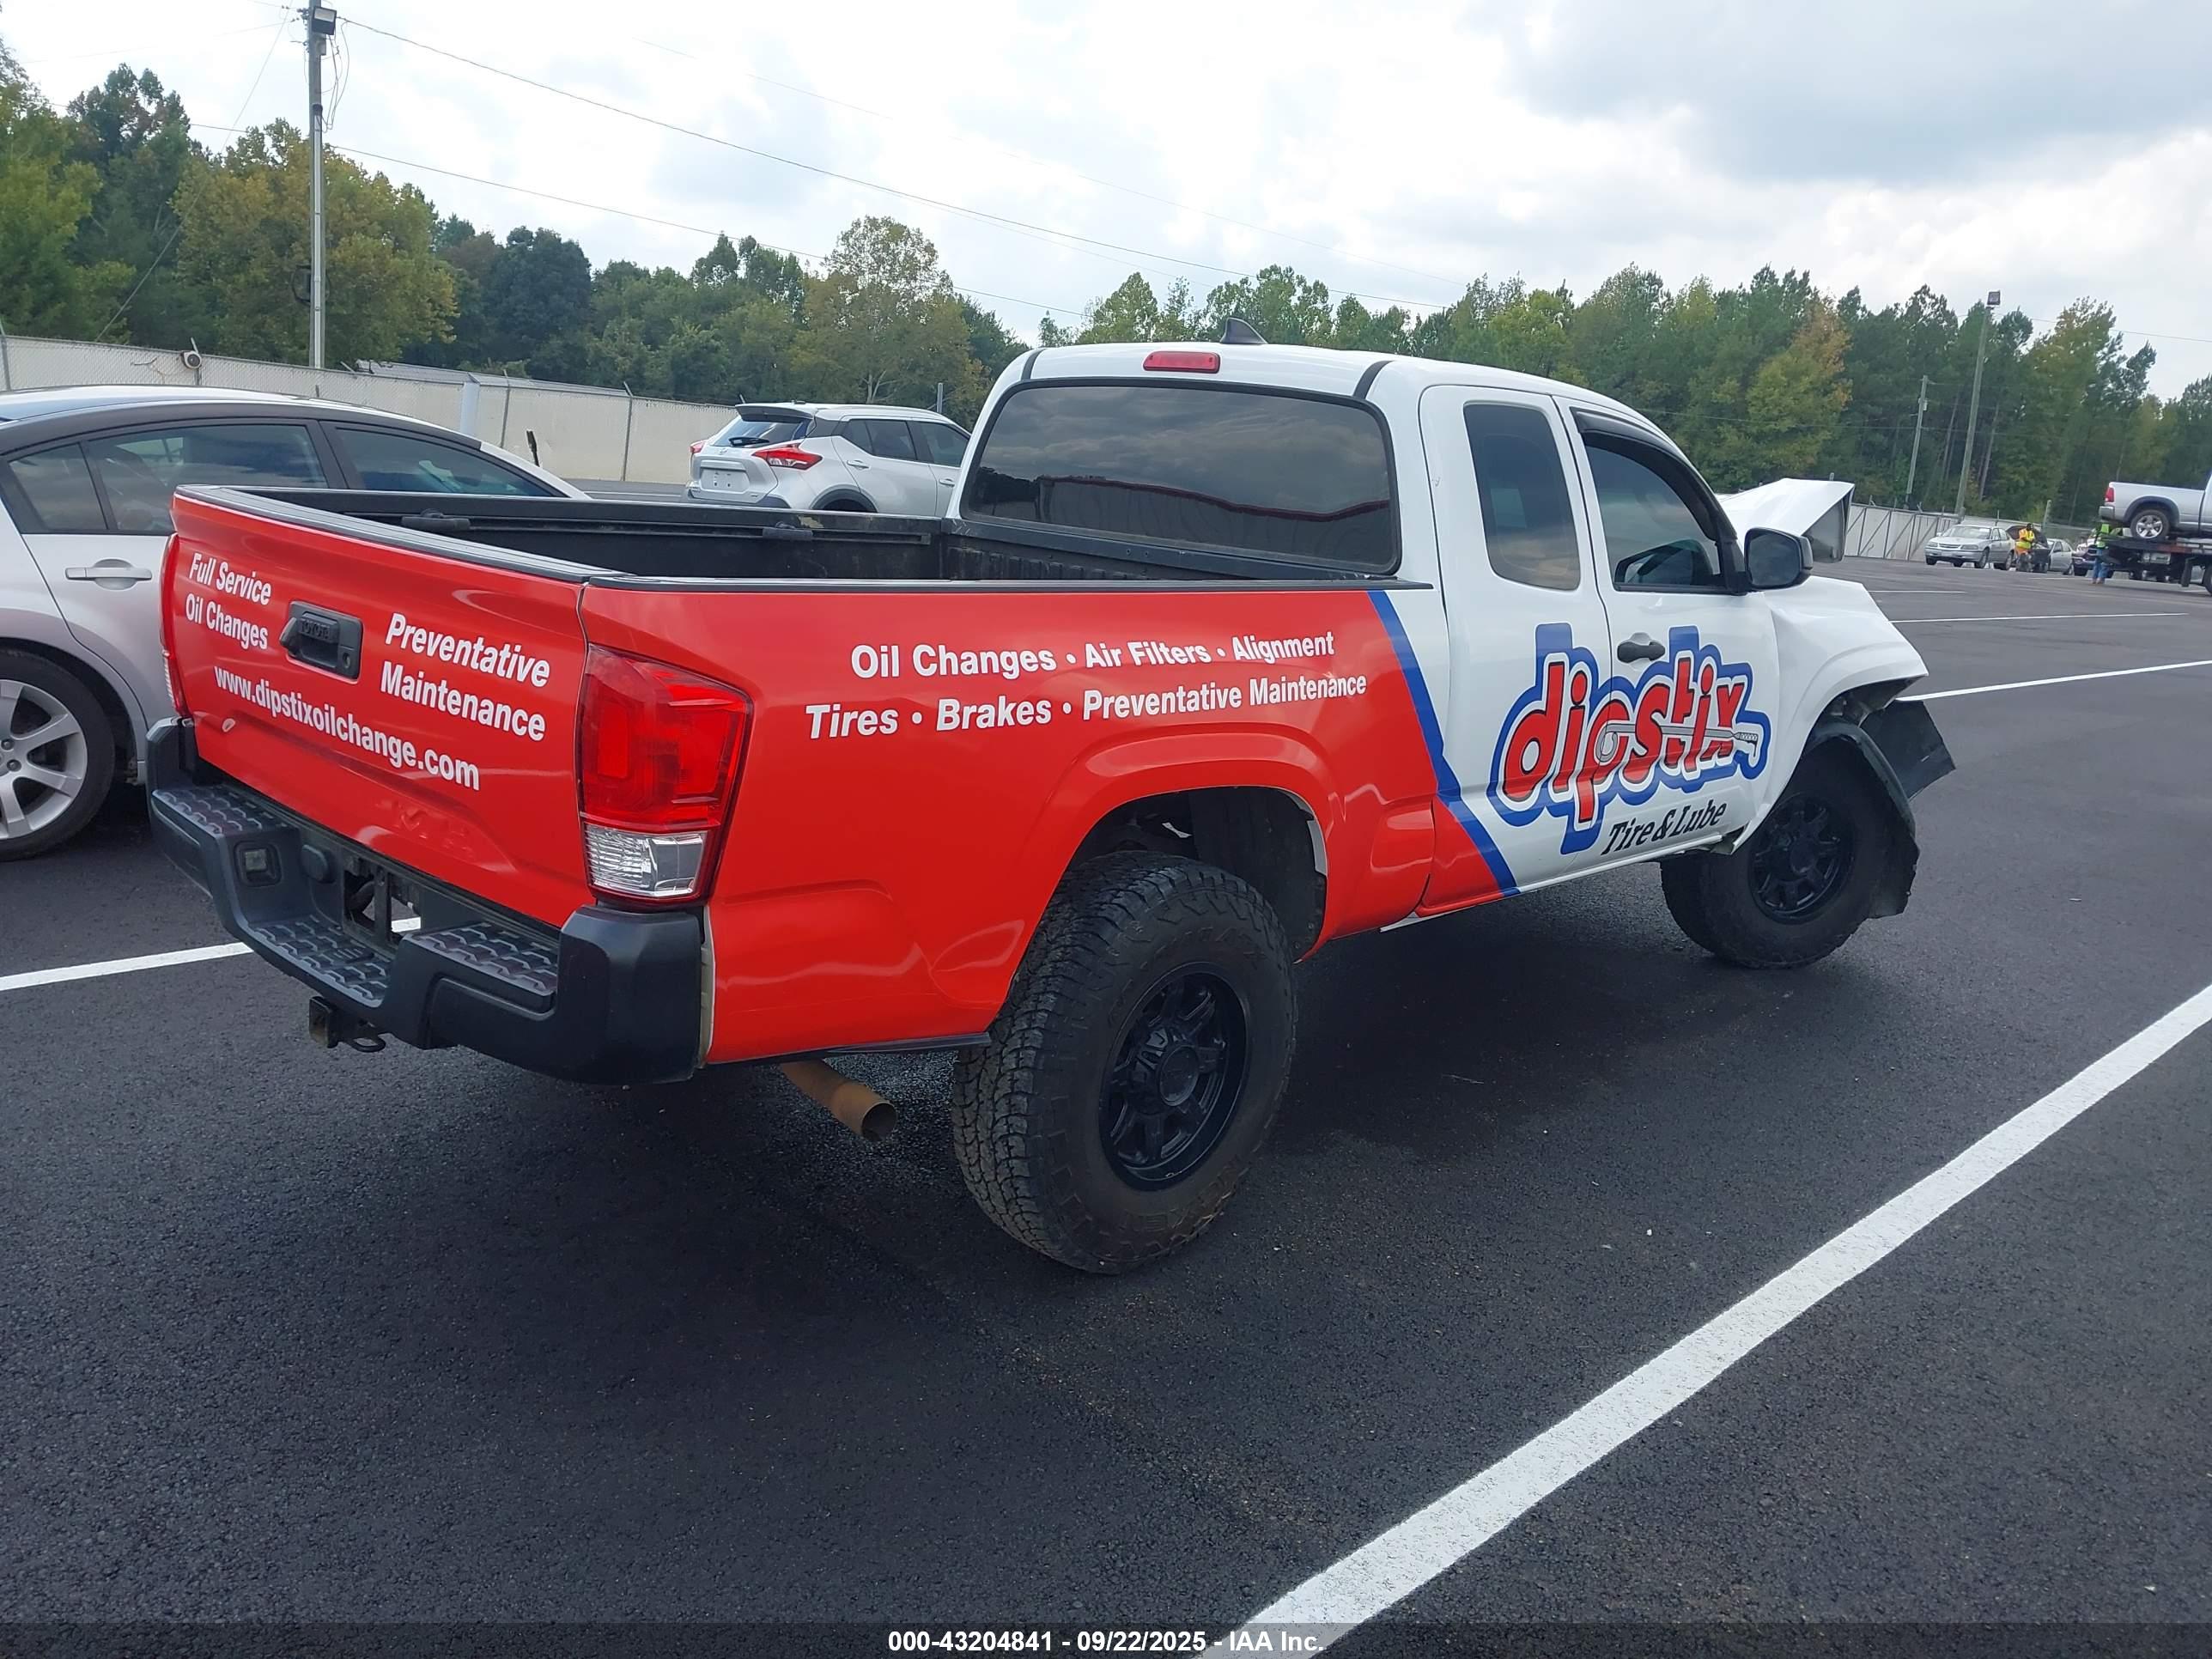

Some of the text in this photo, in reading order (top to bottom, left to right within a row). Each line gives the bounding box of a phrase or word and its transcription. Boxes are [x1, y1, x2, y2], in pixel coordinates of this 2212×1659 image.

[188, 552, 272, 605] Full Service
[185, 592, 269, 649] Oil Changes
[385, 612, 550, 689] Preventative
[851, 630, 1335, 680] Oil Changes Air Filters Alignment
[214, 666, 480, 791] www.dipstixoilchange.com
[380, 661, 545, 741] Maintenance
[805, 672, 1368, 740] Tires Brakes Preventative Maintenance
